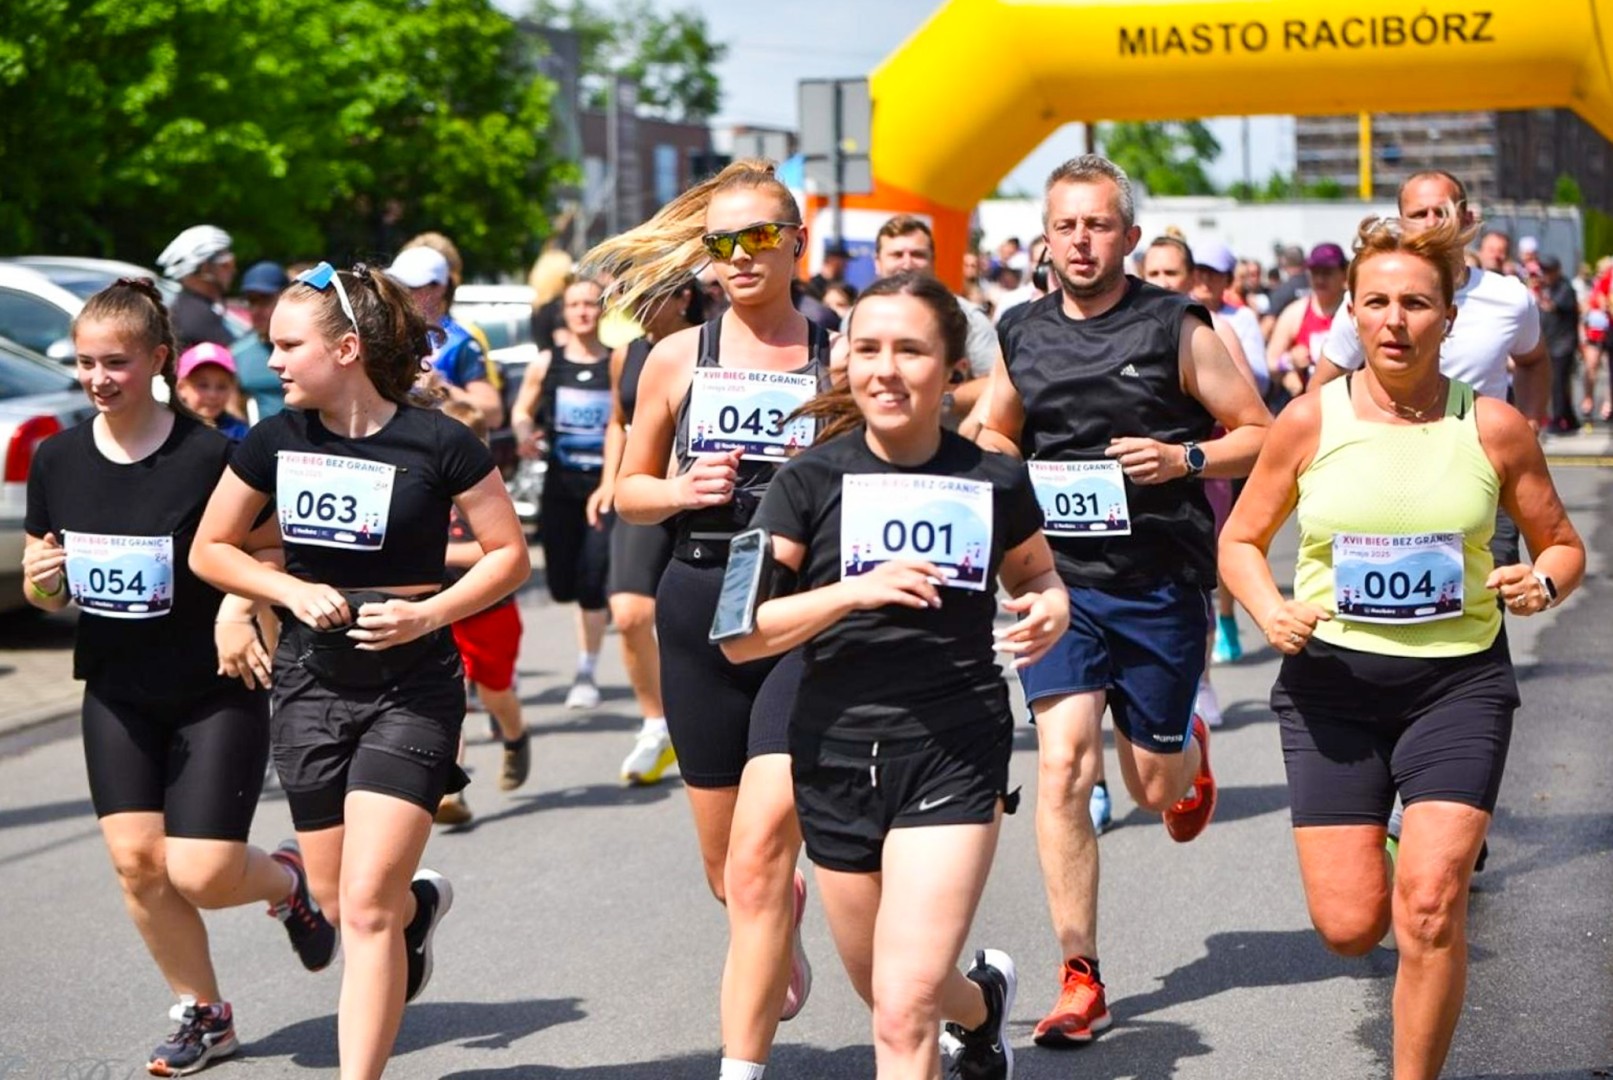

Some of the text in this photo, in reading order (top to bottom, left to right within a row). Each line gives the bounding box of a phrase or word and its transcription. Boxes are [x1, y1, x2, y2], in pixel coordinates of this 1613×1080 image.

[1119, 7, 1495, 58] MIASTO RACIBÓRZ
[703, 371, 807, 386] XVII BIEG BEZ GRANIC
[719, 405, 784, 438] 043
[302, 456, 323, 466] BIEG
[326, 458, 344, 468] BEZ
[346, 461, 385, 474] GRANIC
[1049, 463, 1065, 472] BIEG
[1067, 464, 1081, 472] BEZ
[1082, 463, 1114, 471] GRANIC
[913, 480, 935, 489] BEZ
[938, 481, 981, 495] GRANIC
[296, 490, 357, 524] 063
[1055, 492, 1099, 516] 031
[110, 538, 126, 546] BEZ
[128, 538, 164, 547] GRANIC
[883, 519, 952, 555] 001
[1343, 533, 1454, 547] XVII BIEG BEZ GRANIC
[1370, 549, 1391, 558] 2025
[89, 568, 147, 596] 054
[1364, 569, 1436, 600] 004
